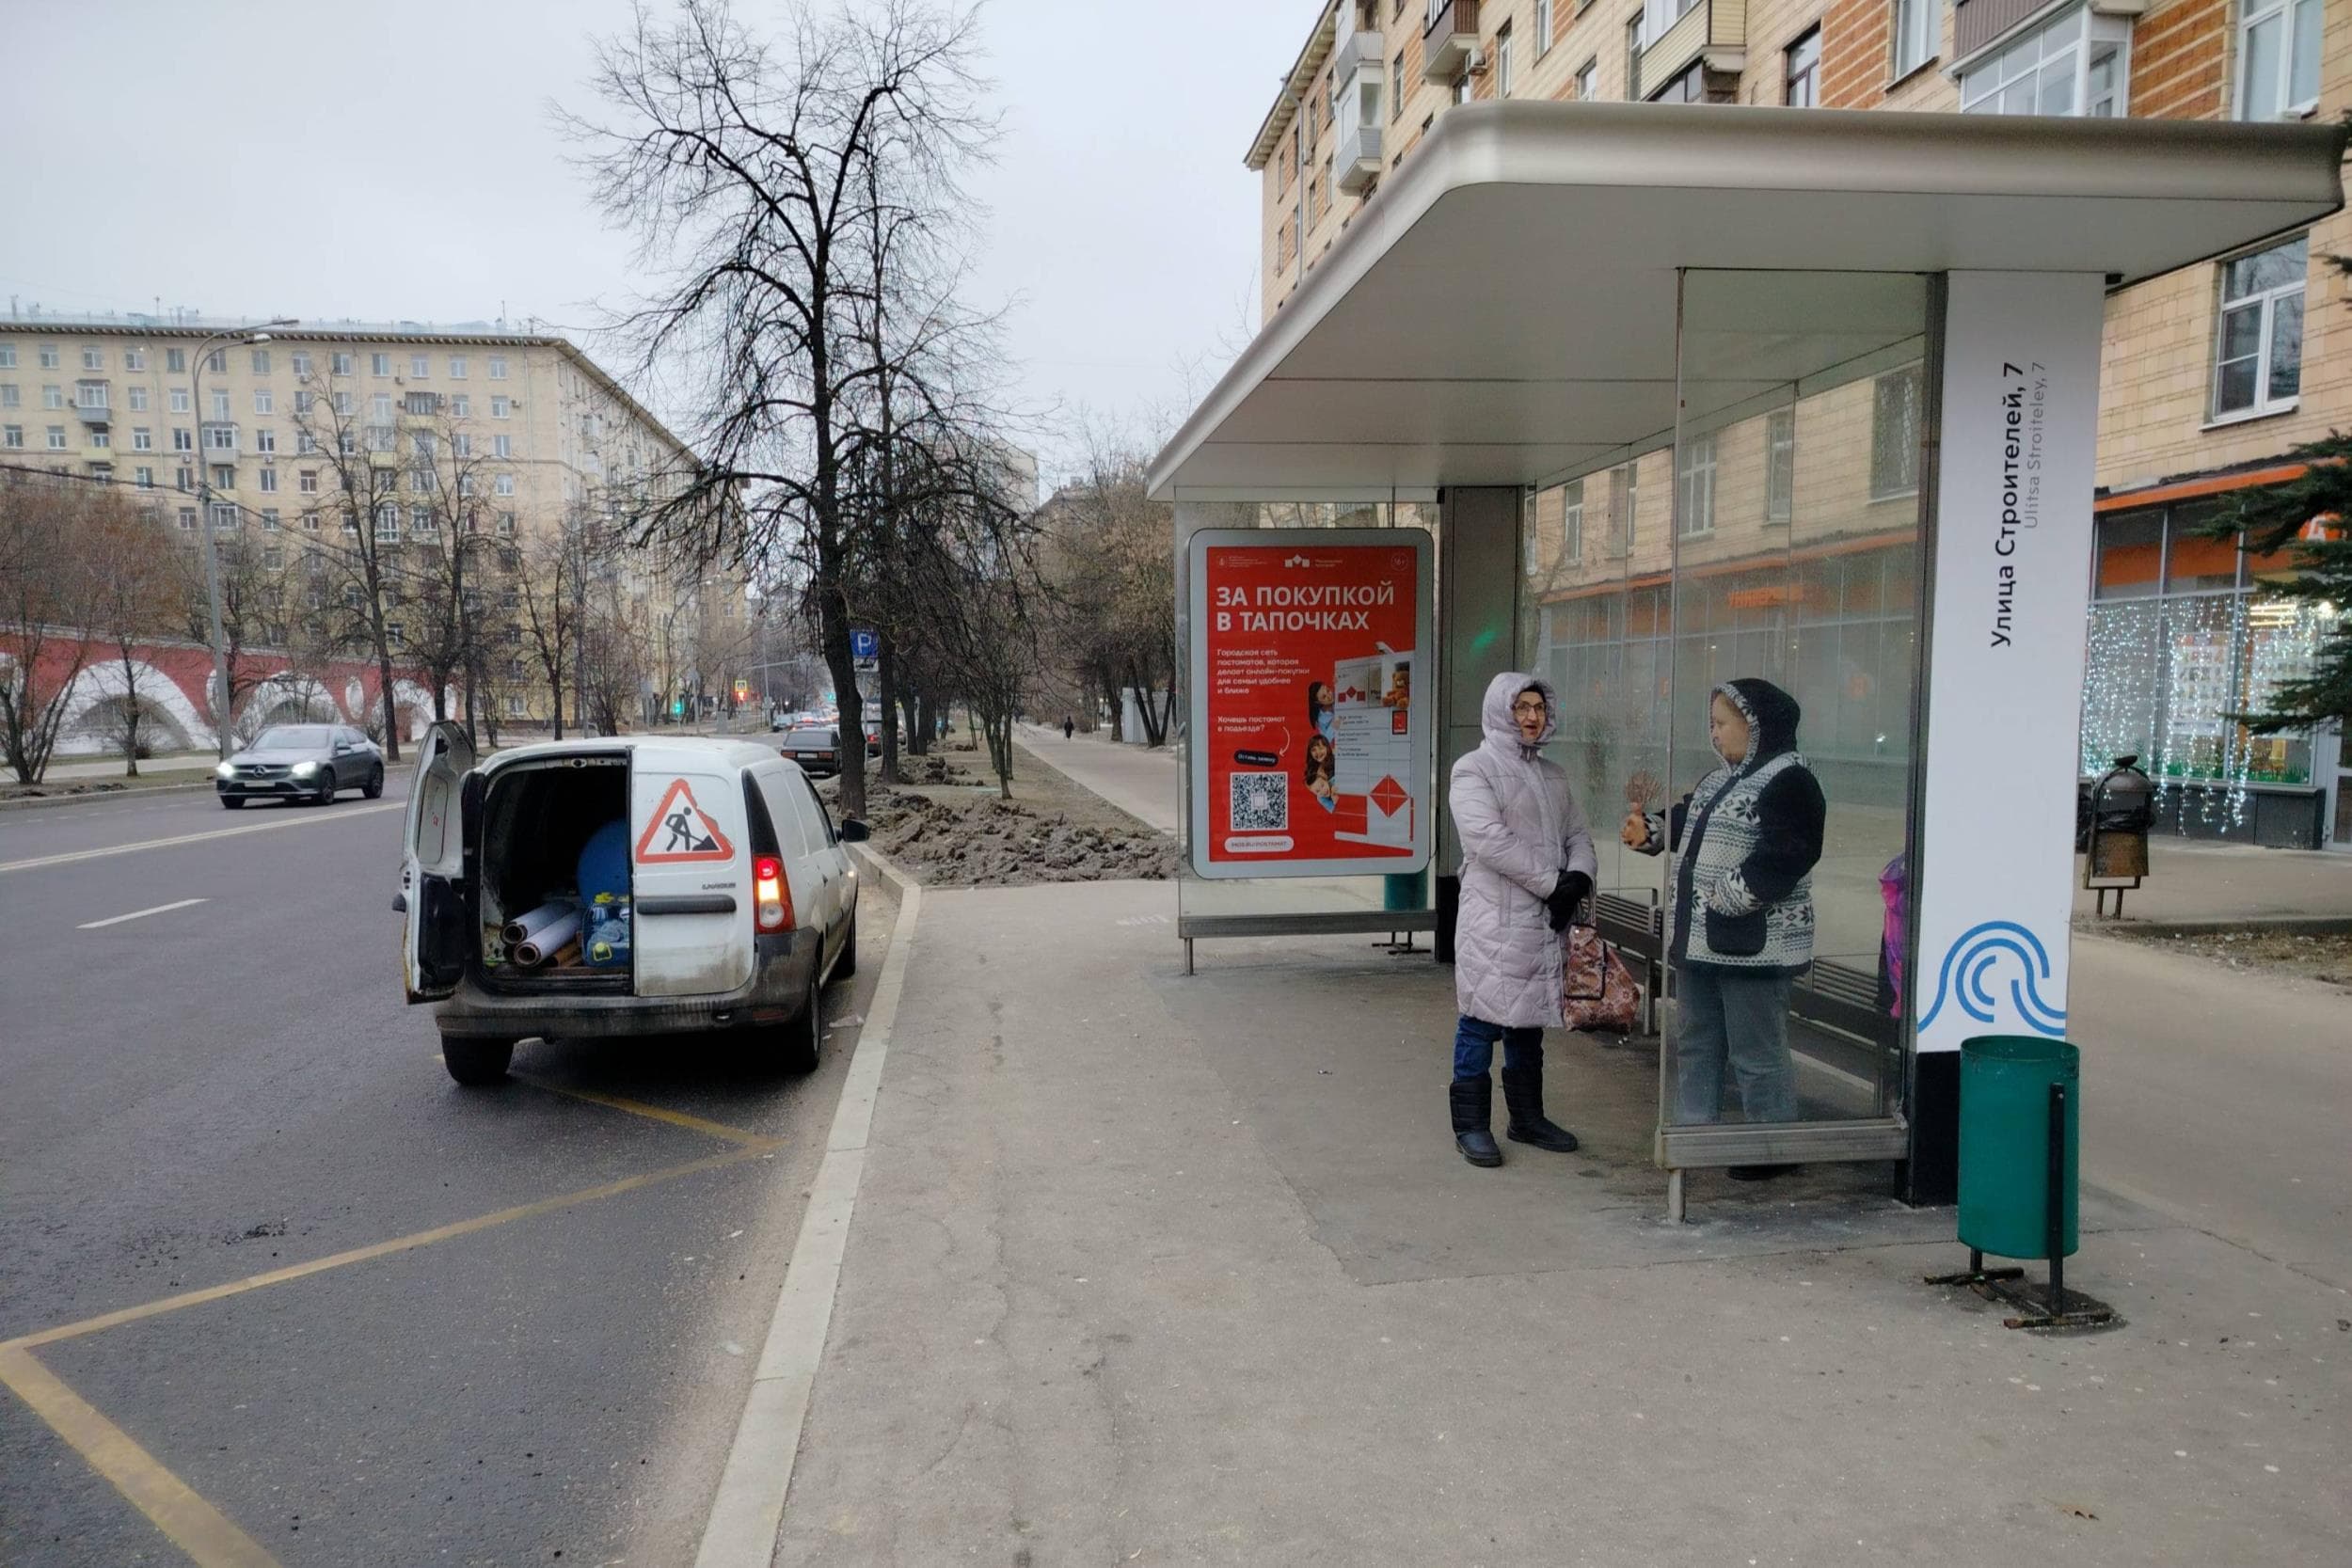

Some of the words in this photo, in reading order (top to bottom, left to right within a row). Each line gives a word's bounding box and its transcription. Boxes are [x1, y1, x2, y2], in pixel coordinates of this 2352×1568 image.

[2002, 361, 2024, 377] 7
[2031, 361, 2045, 372] 7
[2026, 378, 2047, 470] Stroiteley,
[1994, 387, 2026, 557] Строителей,
[2024, 476, 2040, 529] Ulitsa
[1216, 586, 1248, 607] ЗА
[1256, 579, 1394, 607] ПОКУПКОЙ
[1990, 565, 2017, 648] Улица
[1216, 611, 1232, 632] В
[1239, 610, 1370, 631] ТАПОЧКАХ
[1216, 648, 1259, 657] Городская
